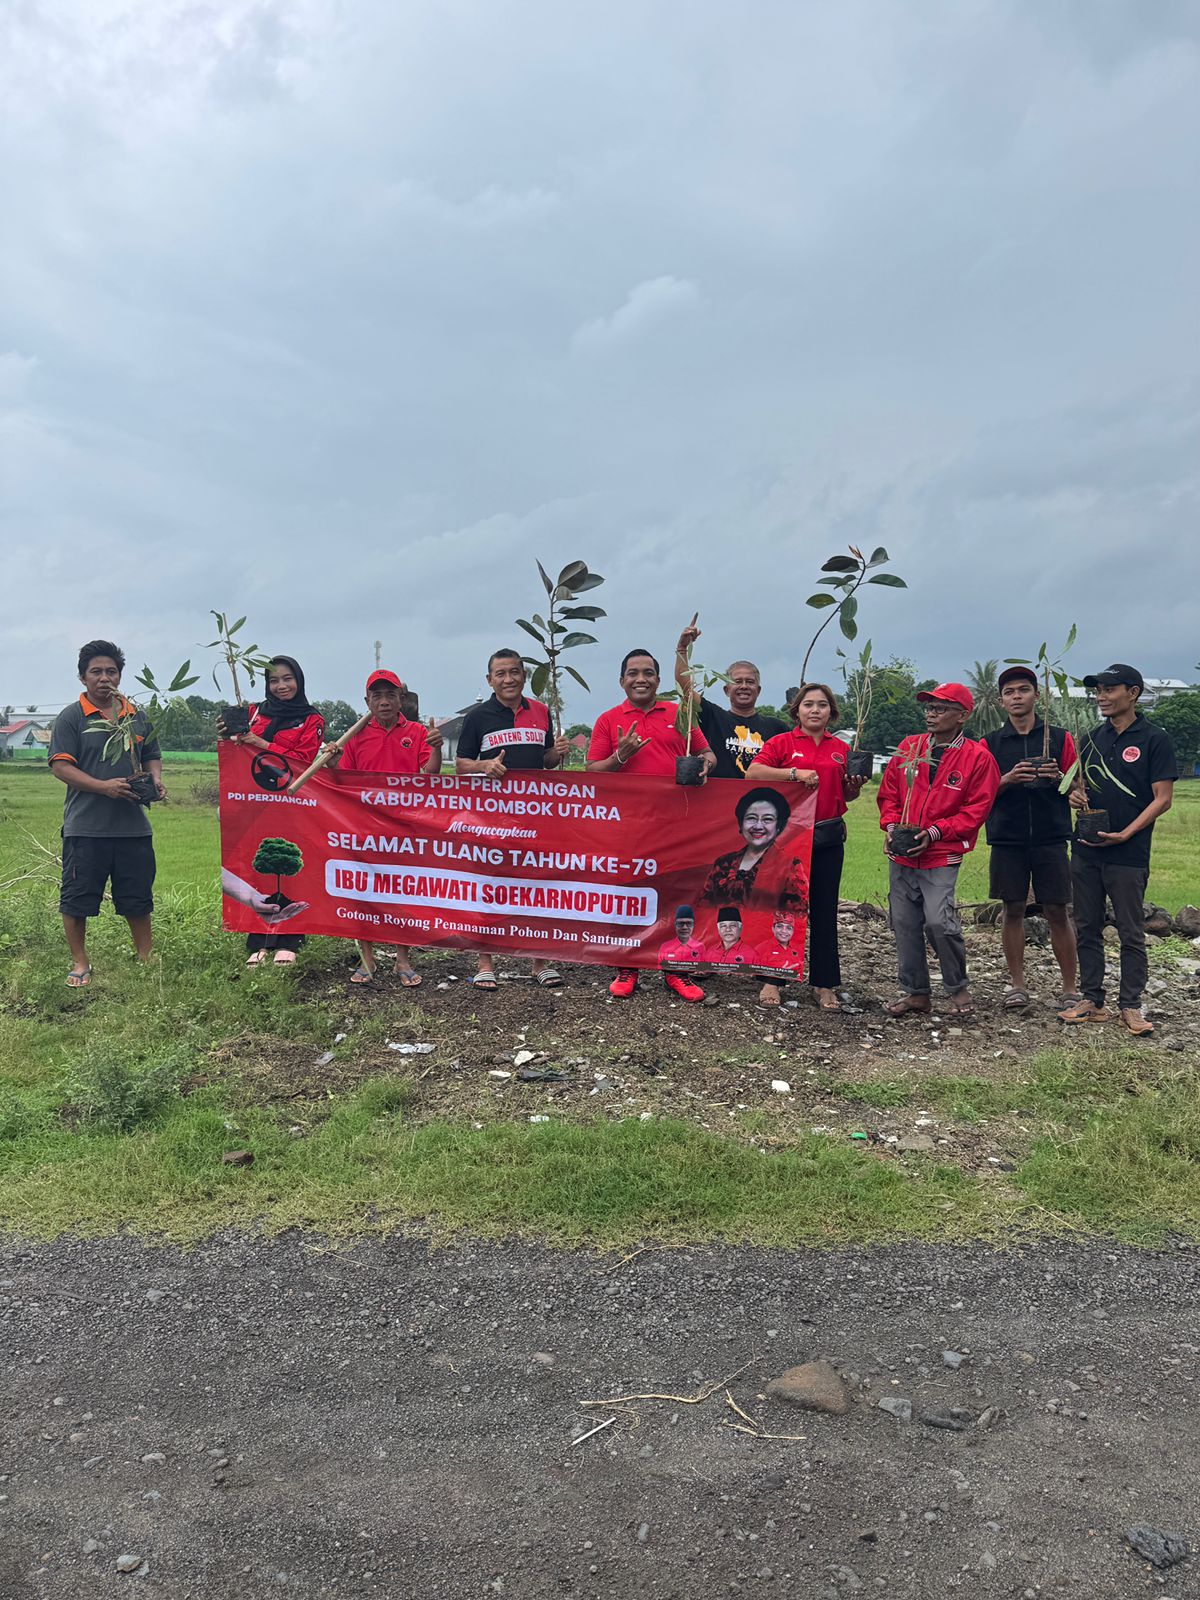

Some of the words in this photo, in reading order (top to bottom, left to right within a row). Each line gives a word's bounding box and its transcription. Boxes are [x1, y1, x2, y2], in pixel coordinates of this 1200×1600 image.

[488, 731, 522, 747] BANTENG
[525, 731, 544, 743] SOLID
[227, 792, 246, 801] PDI
[247, 793, 318, 807] PERJUANGAN
[386, 776, 426, 788] DPC
[430, 776, 596, 799] PDI-PERJUANGAN
[360, 791, 472, 810] KABUPATEN
[475, 798, 554, 817] LOMBOK
[558, 805, 621, 822] UTARA
[444, 820, 537, 840] Mengucapkan
[327, 831, 428, 854] SELAMAT
[432, 840, 504, 865] ULANG
[508, 849, 586, 871] TAHUN
[591, 855, 658, 876] KE-79
[335, 868, 368, 893] IBU
[373, 873, 477, 902] MEGAWATI
[481, 883, 648, 917] SOEKARNOPUTRI
[336, 907, 380, 925] Gotong
[383, 913, 430, 931] Royong
[434, 917, 506, 936] Penanaman
[509, 925, 549, 939] Pohon
[552, 928, 578, 942] Dan
[581, 931, 642, 948] Santunan
